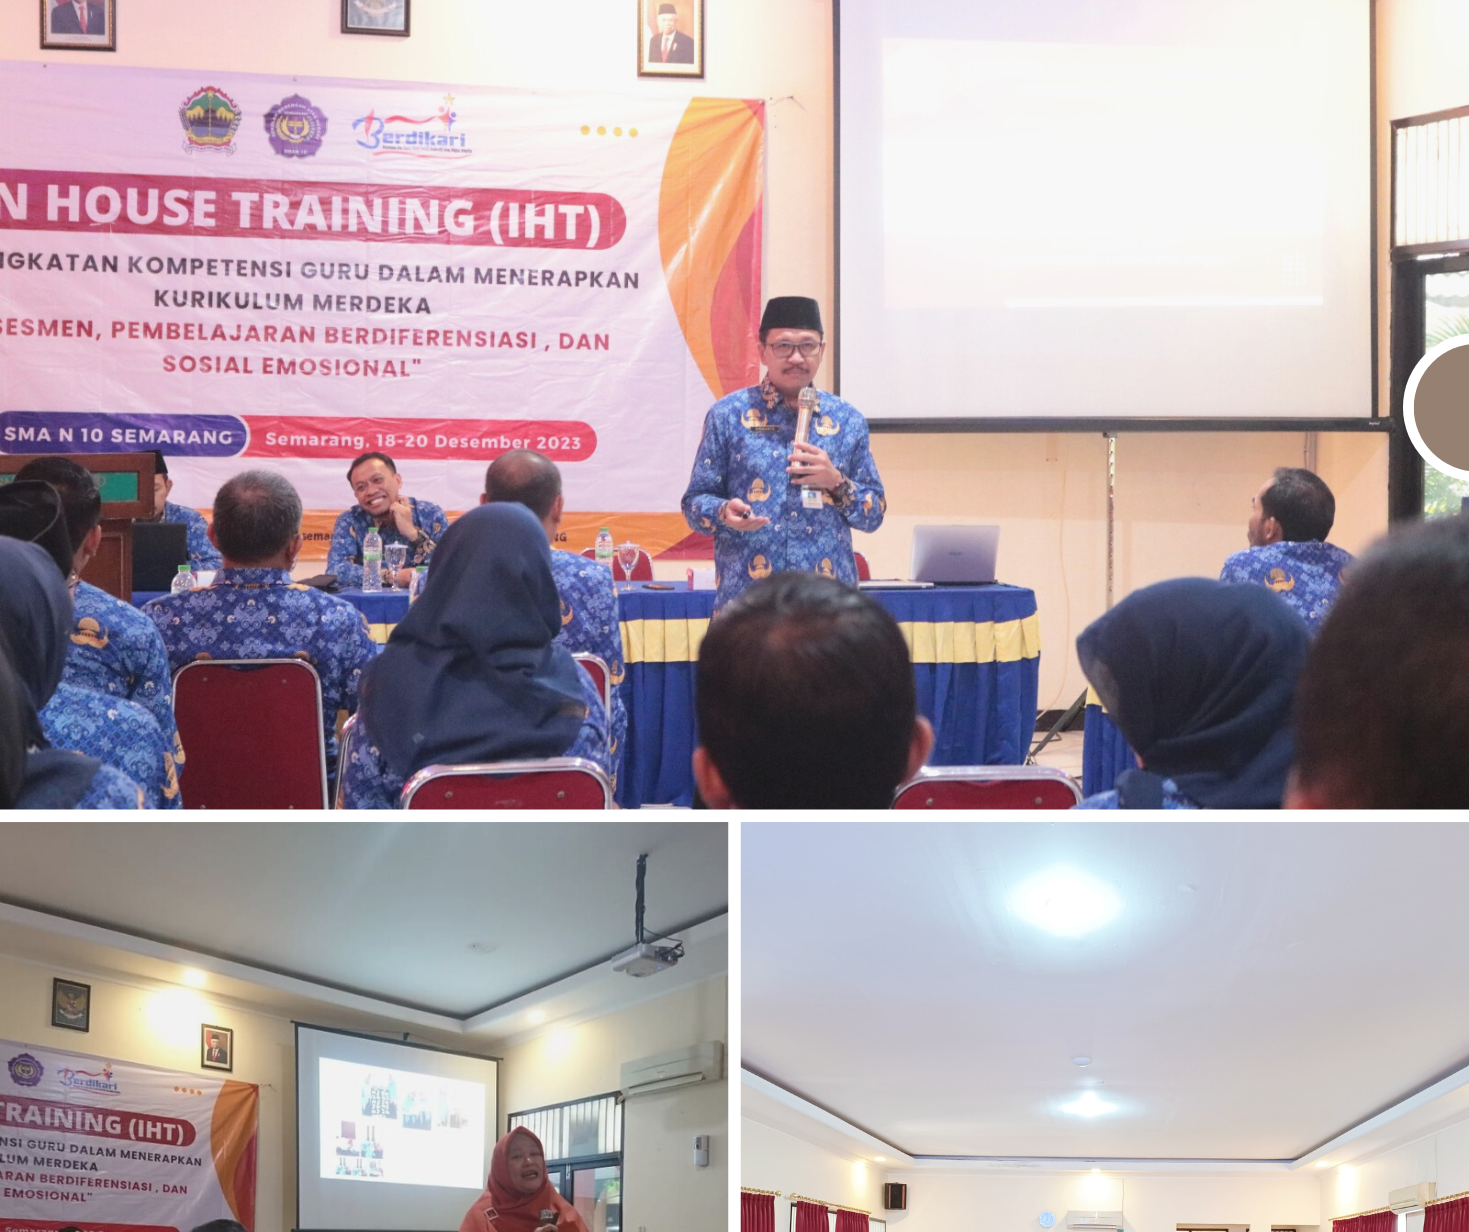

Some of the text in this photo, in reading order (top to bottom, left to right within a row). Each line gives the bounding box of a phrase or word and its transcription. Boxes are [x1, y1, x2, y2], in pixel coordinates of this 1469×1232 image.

[352, 116, 466, 150] Berdikari
[47, 184, 216, 227] HOUSE
[231, 190, 475, 236] TRAINING
[490, 200, 600, 248] (IHT)
[0, 252, 639, 289] GKATAN KOMPETENSI GURU DALAM MENERAPKAN
[154, 289, 432, 314] KURIKULUM MERDEKA
[0, 318, 102, 341] ESMEN,
[111, 321, 315, 343] PEMBELAJARAN
[324, 327, 537, 349] BERDIFERENSIASI
[559, 333, 610, 350] DAN
[162, 355, 421, 377] SOSIAL EMOSIONAL"
[4, 427, 233, 445] SMA N 10 SEMARANG
[265, 432, 582, 450] Semarang, 18-20 Desember 2023
[129, 1118, 184, 1145] (IHT)
[27, 1139, 66, 1152] GURU
[70, 1144, 117, 1158] DALAM
[120, 1150, 202, 1166] MENERAPKAN
[33, 1158, 98, 1172] MERDEKA
[3, 1187, 93, 1203] EMOSIONAL"
[39, 1174, 152, 1191] BERDIFERENSIASI
[162, 1184, 188, 1194] DAN
